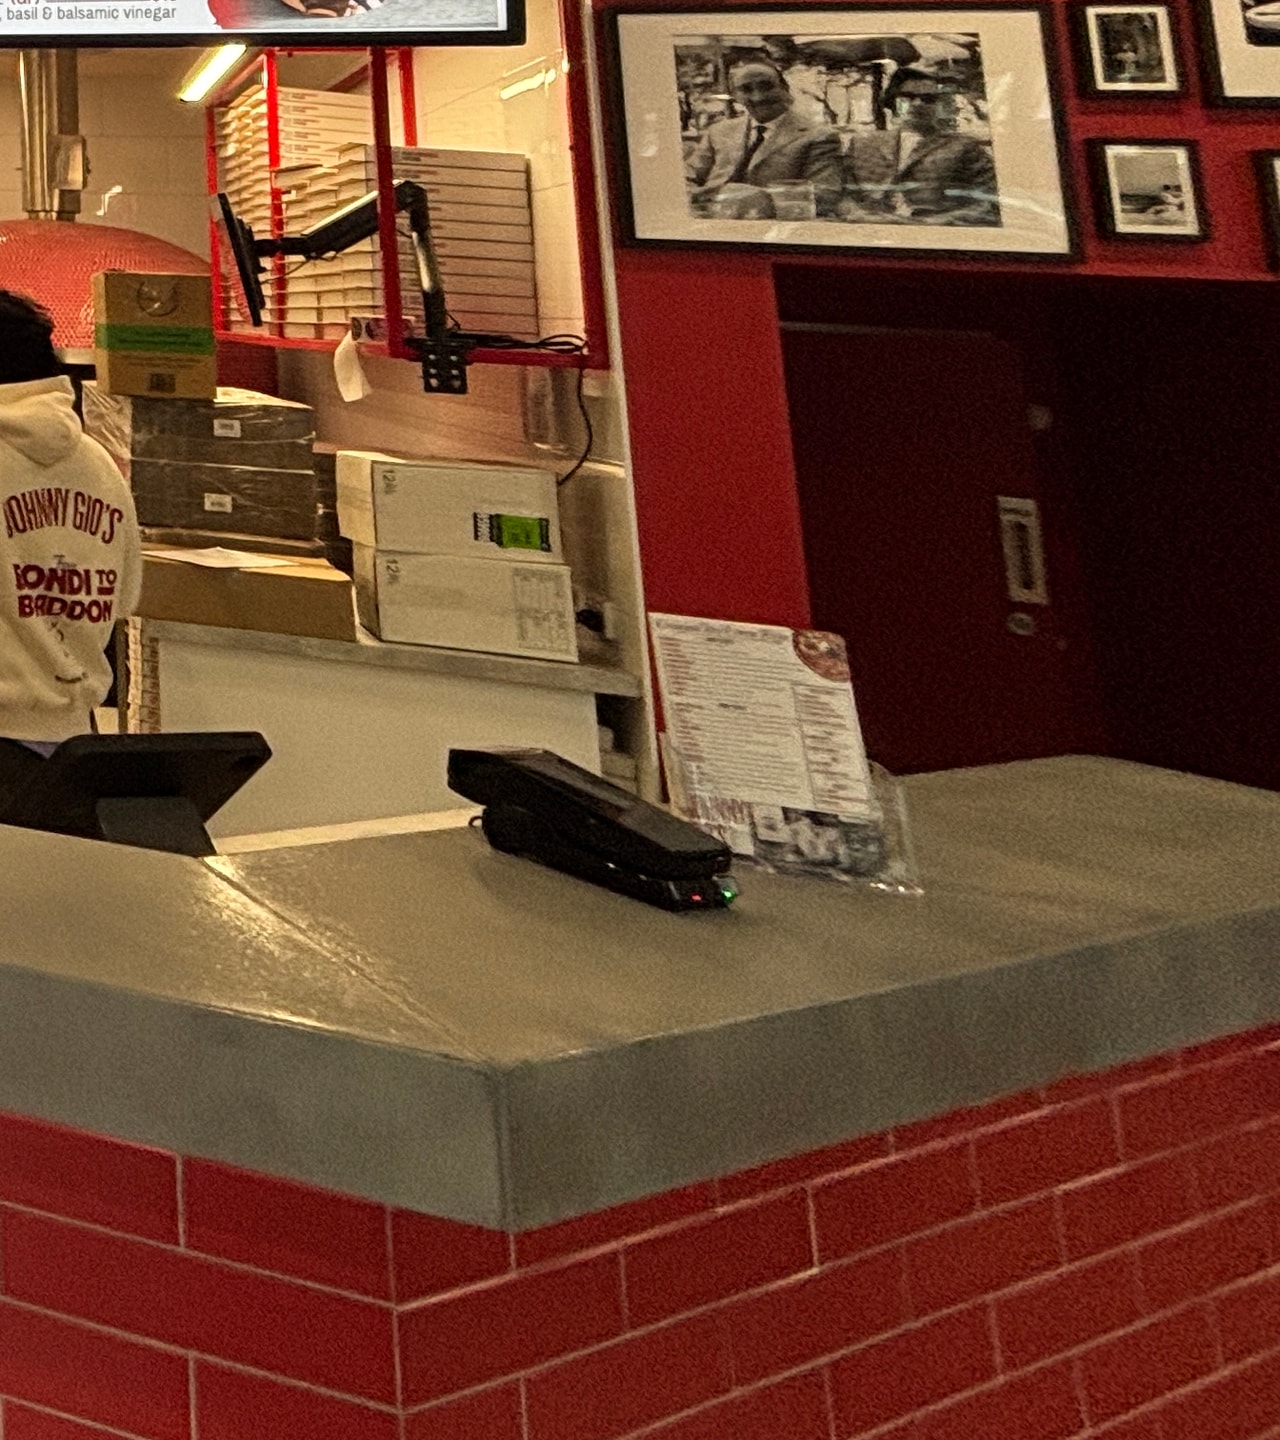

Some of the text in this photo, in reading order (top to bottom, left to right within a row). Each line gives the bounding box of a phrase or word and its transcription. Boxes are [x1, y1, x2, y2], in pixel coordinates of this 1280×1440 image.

[6, 7, 38, 20] basil
[42, 6, 53, 20] &
[57, 6, 119, 20] balsamic
[122, 6, 177, 22] vinegar
[3, 488, 124, 544] JOHNNY GIO'S
